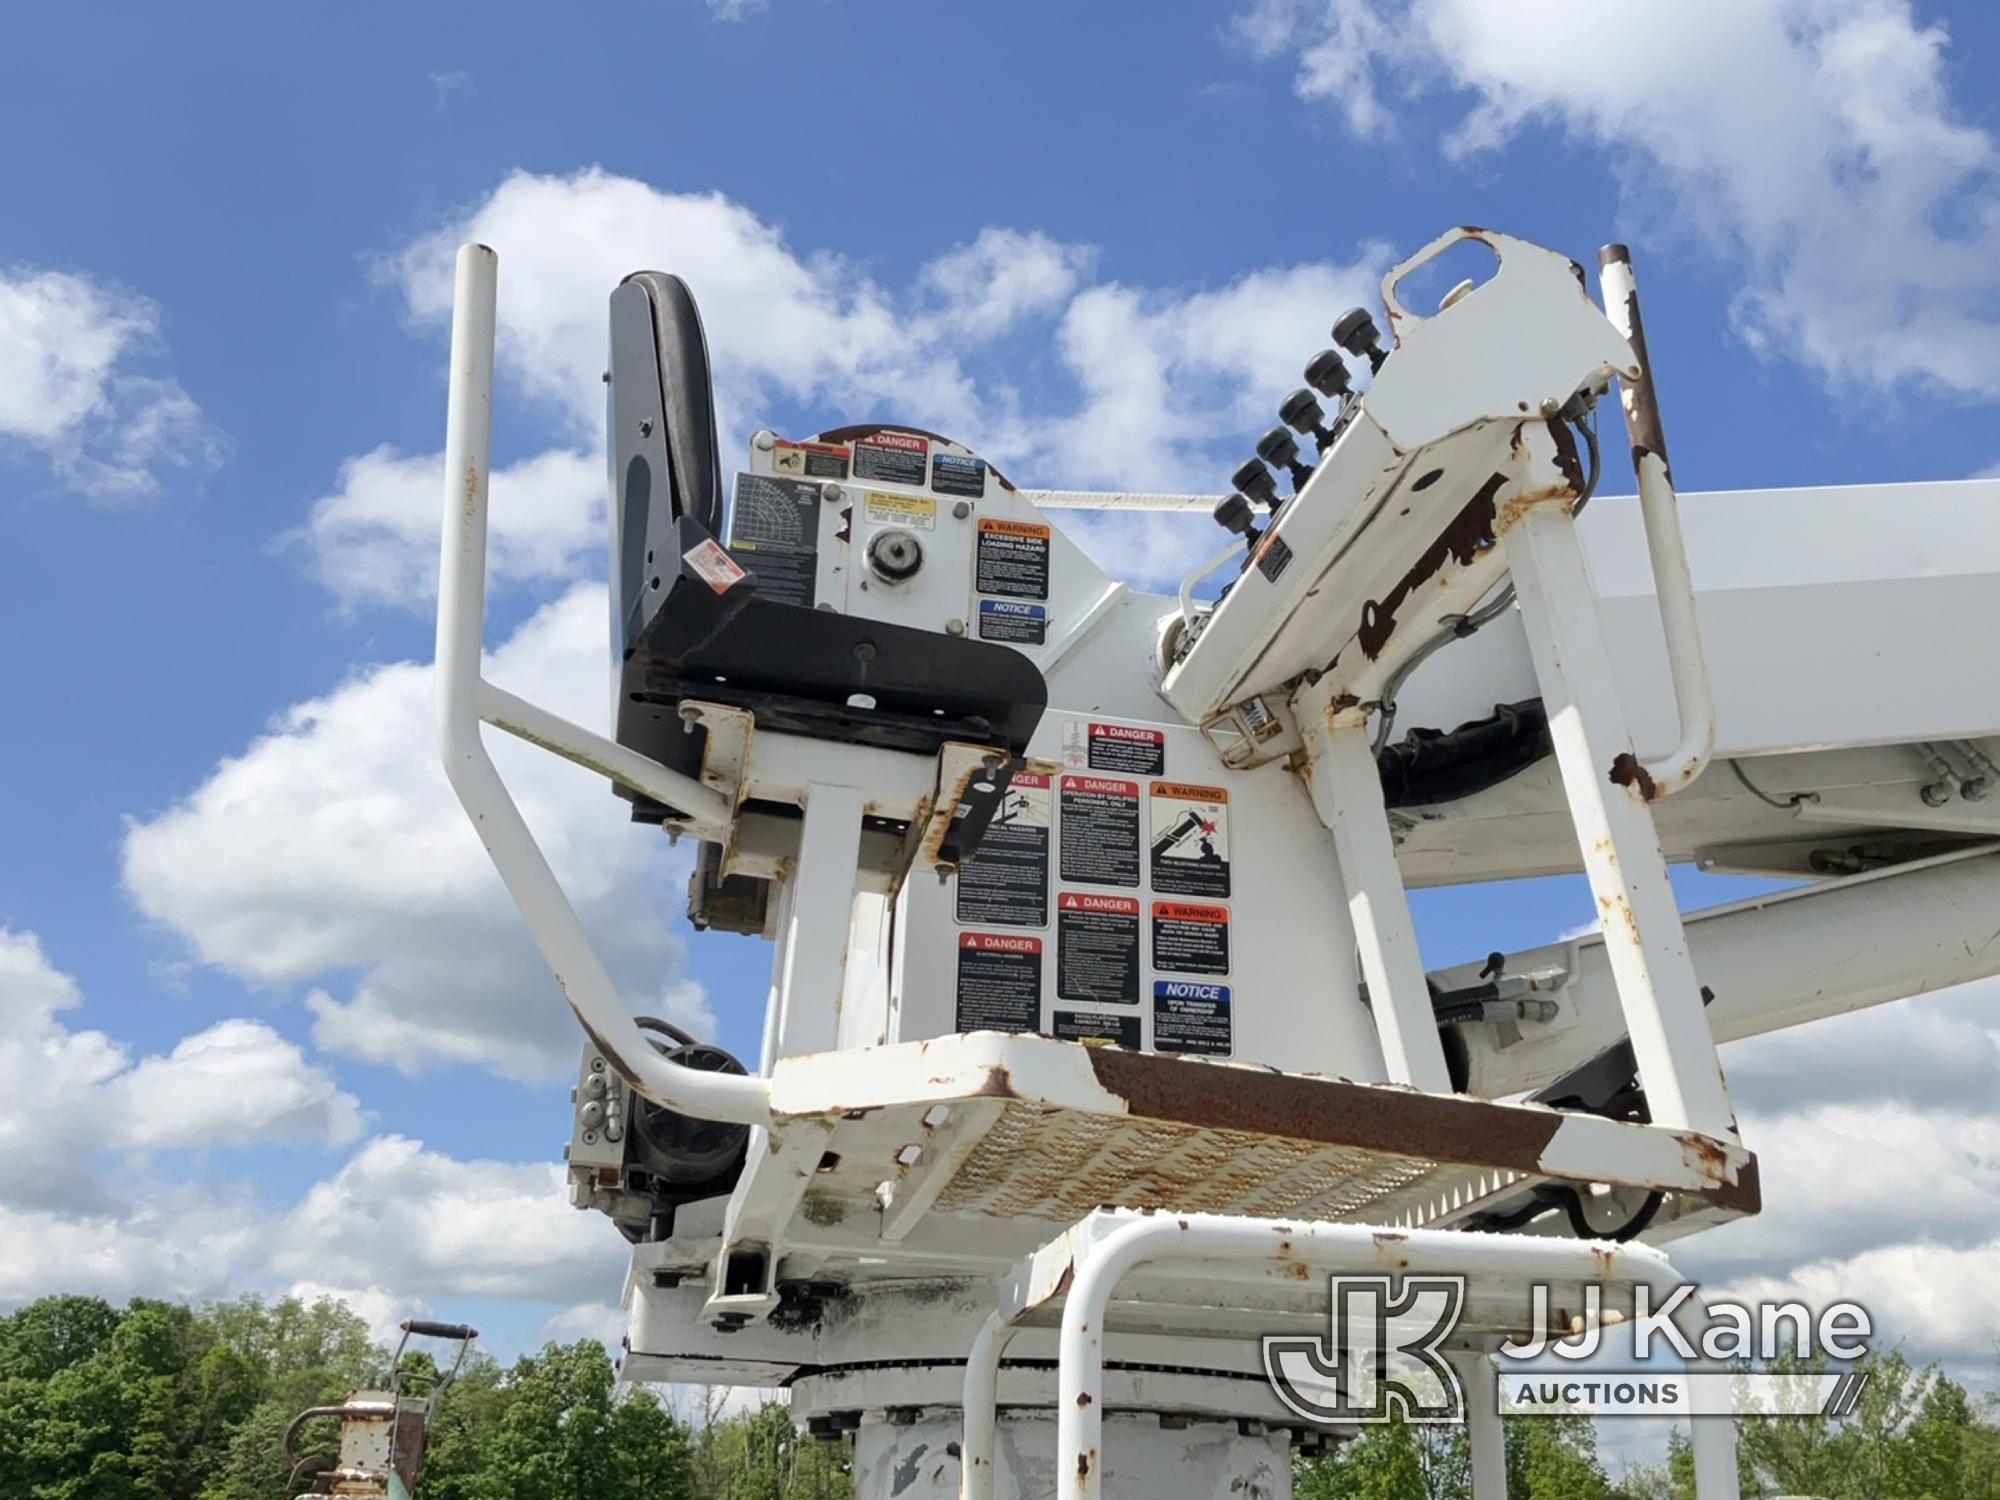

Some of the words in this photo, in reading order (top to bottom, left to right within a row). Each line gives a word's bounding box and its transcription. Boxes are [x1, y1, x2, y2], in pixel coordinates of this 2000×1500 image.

[876, 435, 920, 449] DANGER
[942, 455, 976, 467] NOTICE
[997, 523, 1043, 535] WARNING
[984, 533, 1024, 543] EXCESSIVE
[1025, 537, 1043, 545] SIDE
[981, 540, 1015, 549] LOADING
[1015, 544, 1046, 553] HAZARD
[993, 603, 1032, 615] NOTICE
[1109, 727, 1154, 741] DANGER
[1084, 780, 1126, 793] DANGER
[1171, 786, 1222, 800] WARNING
[1062, 790, 1097, 799] OPERATION
[1083, 897, 1132, 911] DANGER
[1173, 906, 1222, 919] WARNING
[984, 937, 1033, 951] DANGER
[1166, 983, 1221, 1000] NOTICE
[1185, 1000, 1218, 1009] TRANSFER
